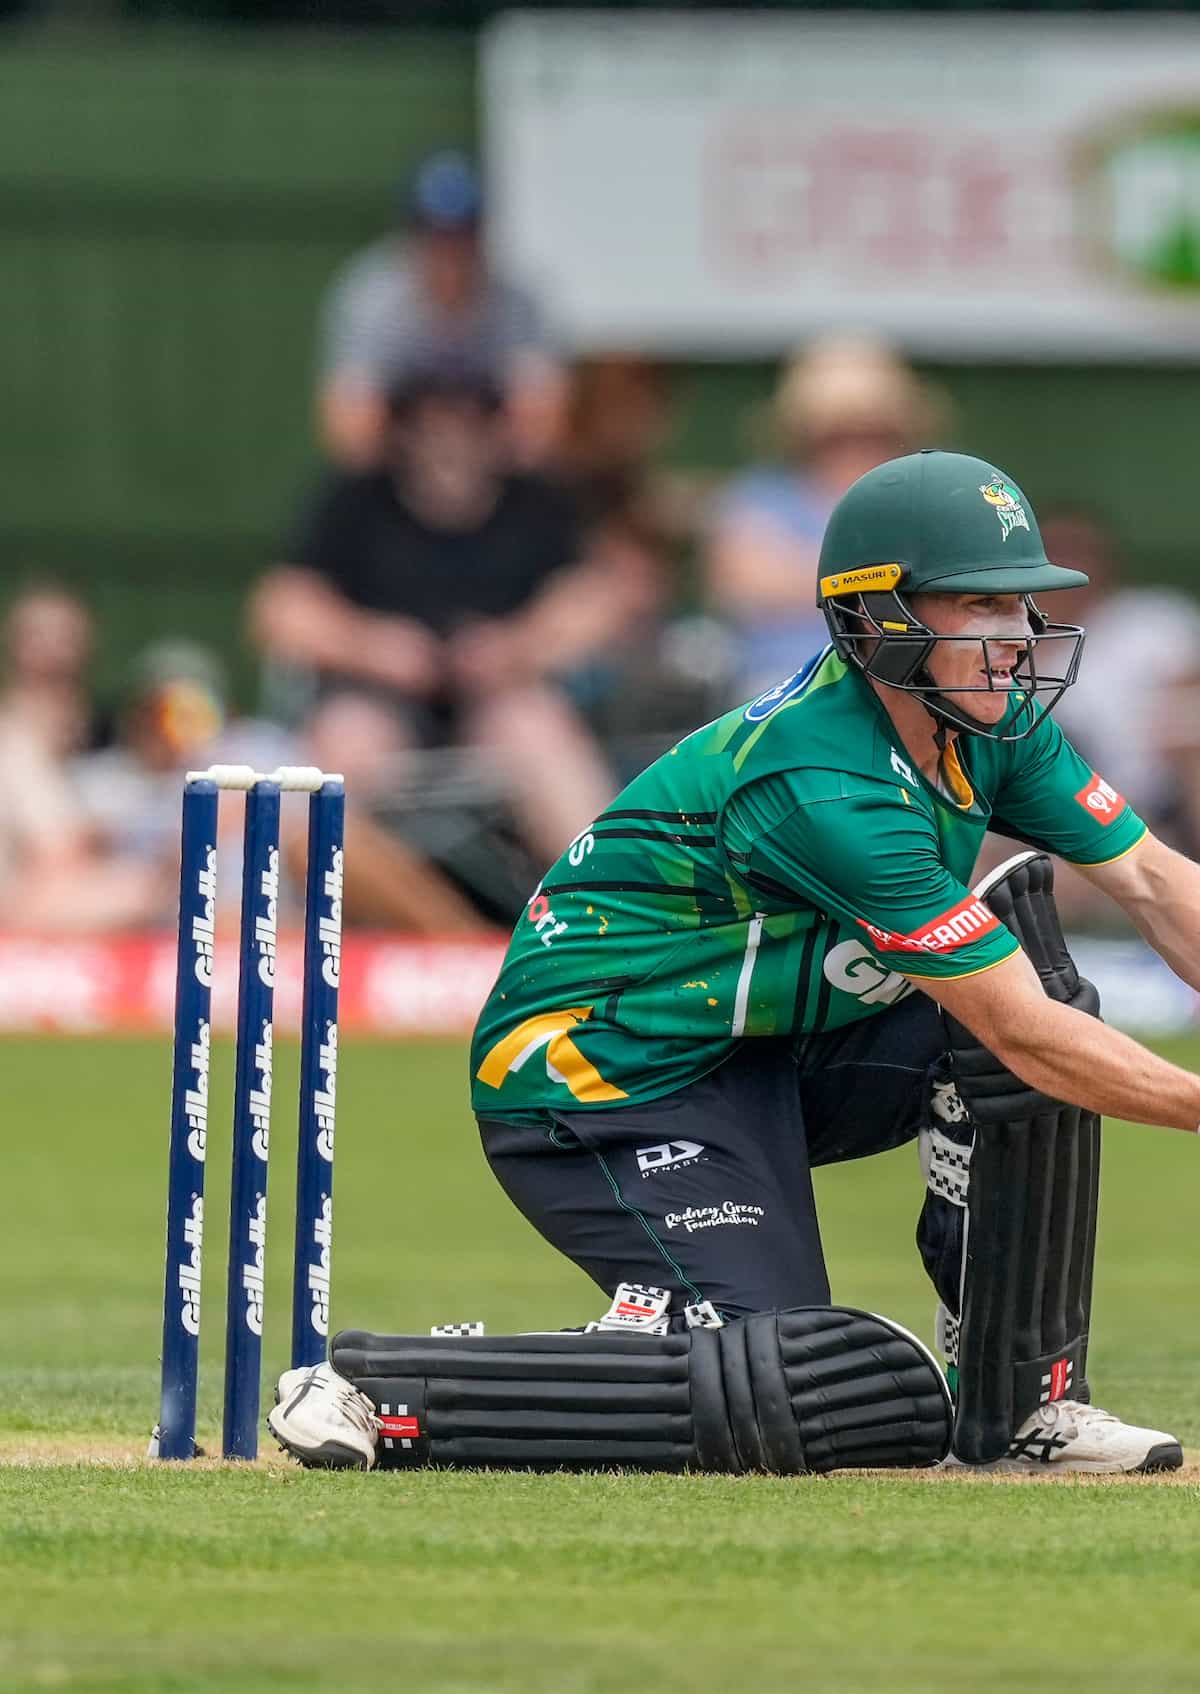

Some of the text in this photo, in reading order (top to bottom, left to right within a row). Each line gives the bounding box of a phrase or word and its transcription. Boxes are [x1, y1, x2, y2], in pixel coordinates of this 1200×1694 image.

[843, 571, 886, 584] MASURI
[665, 1201, 764, 1229] Rodney Green
[684, 1212, 758, 1232] Foundation
